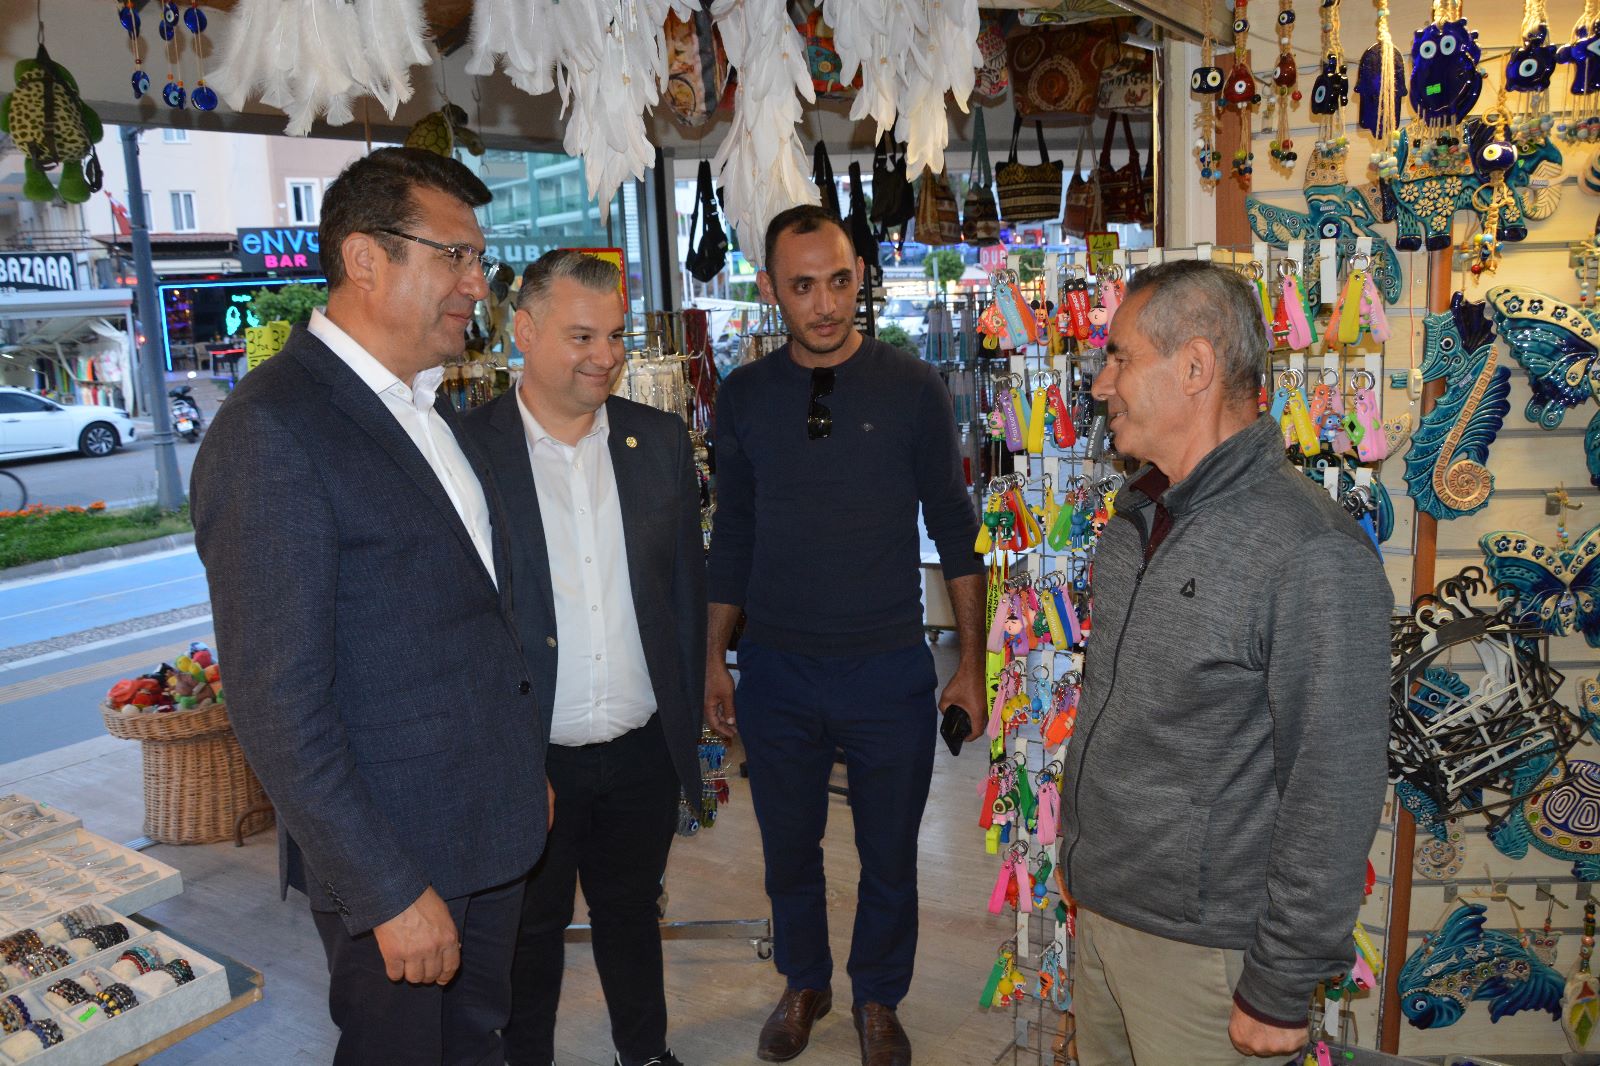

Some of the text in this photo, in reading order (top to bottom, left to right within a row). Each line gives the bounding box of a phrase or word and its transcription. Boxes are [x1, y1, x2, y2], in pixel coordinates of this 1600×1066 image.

[264, 254, 308, 268] BAR
[982, 249, 1006, 266] DUR
[0, 255, 75, 291] BAZAAR
